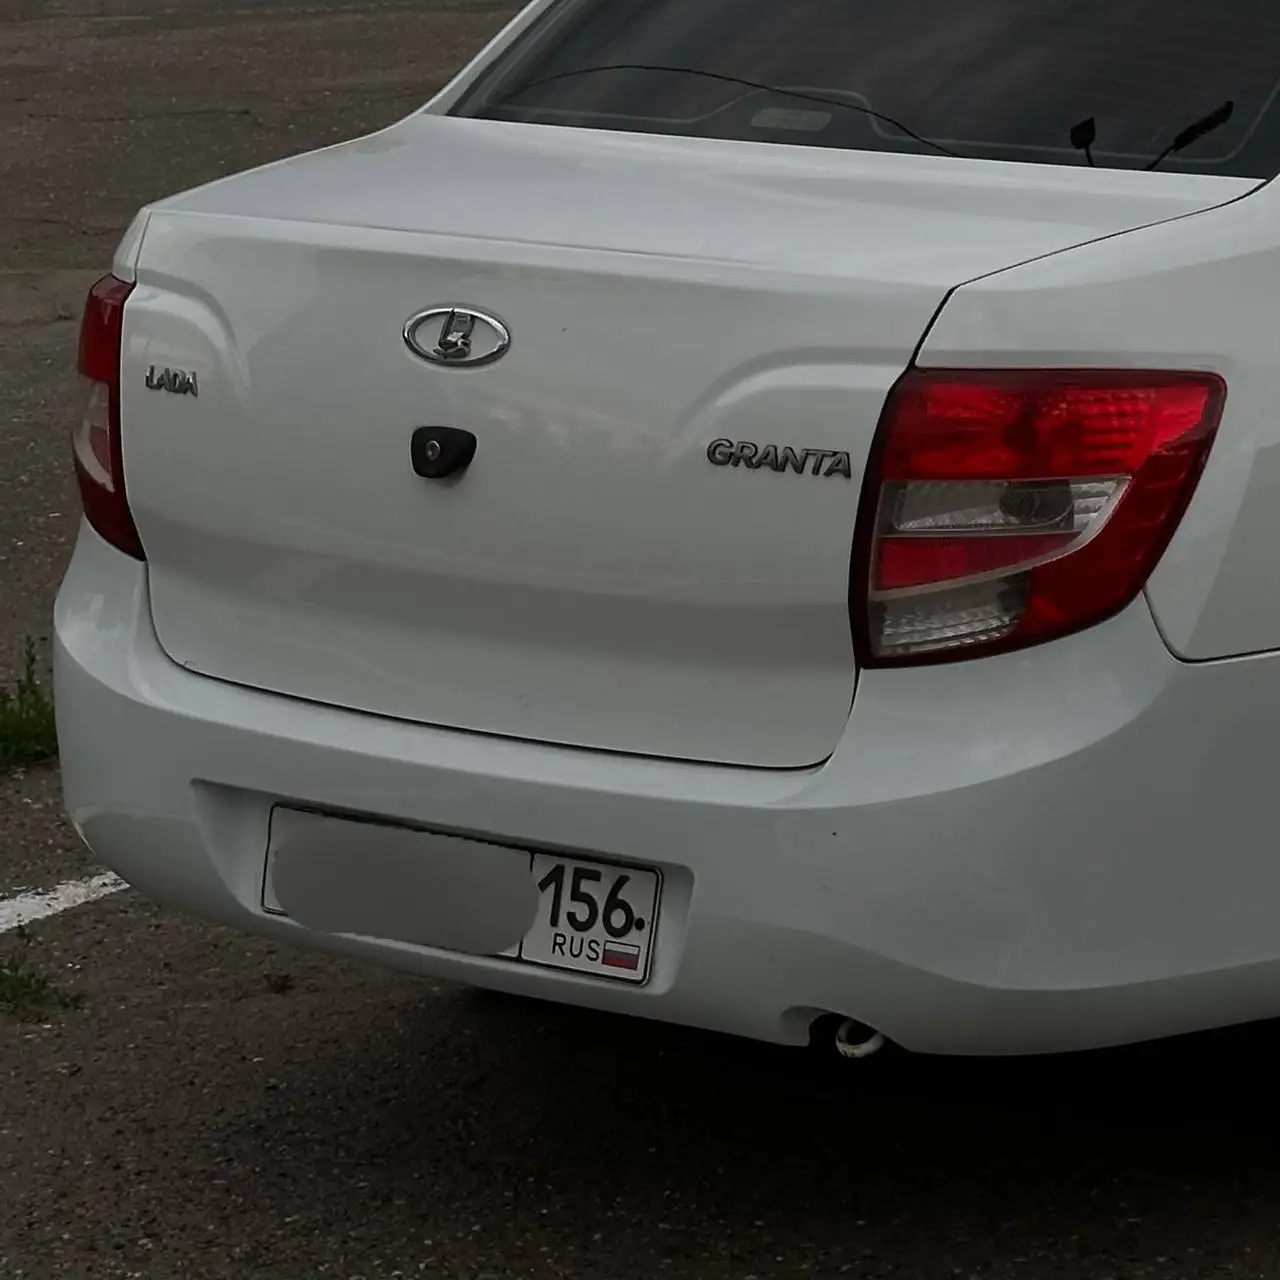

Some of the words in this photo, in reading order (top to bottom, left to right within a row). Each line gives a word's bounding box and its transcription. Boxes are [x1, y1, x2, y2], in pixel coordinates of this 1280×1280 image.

[145, 365, 198, 399] LADA
[707, 438, 852, 478] GRANTA
[538, 864, 634, 938] 156
[551, 932, 600, 962] RUS
